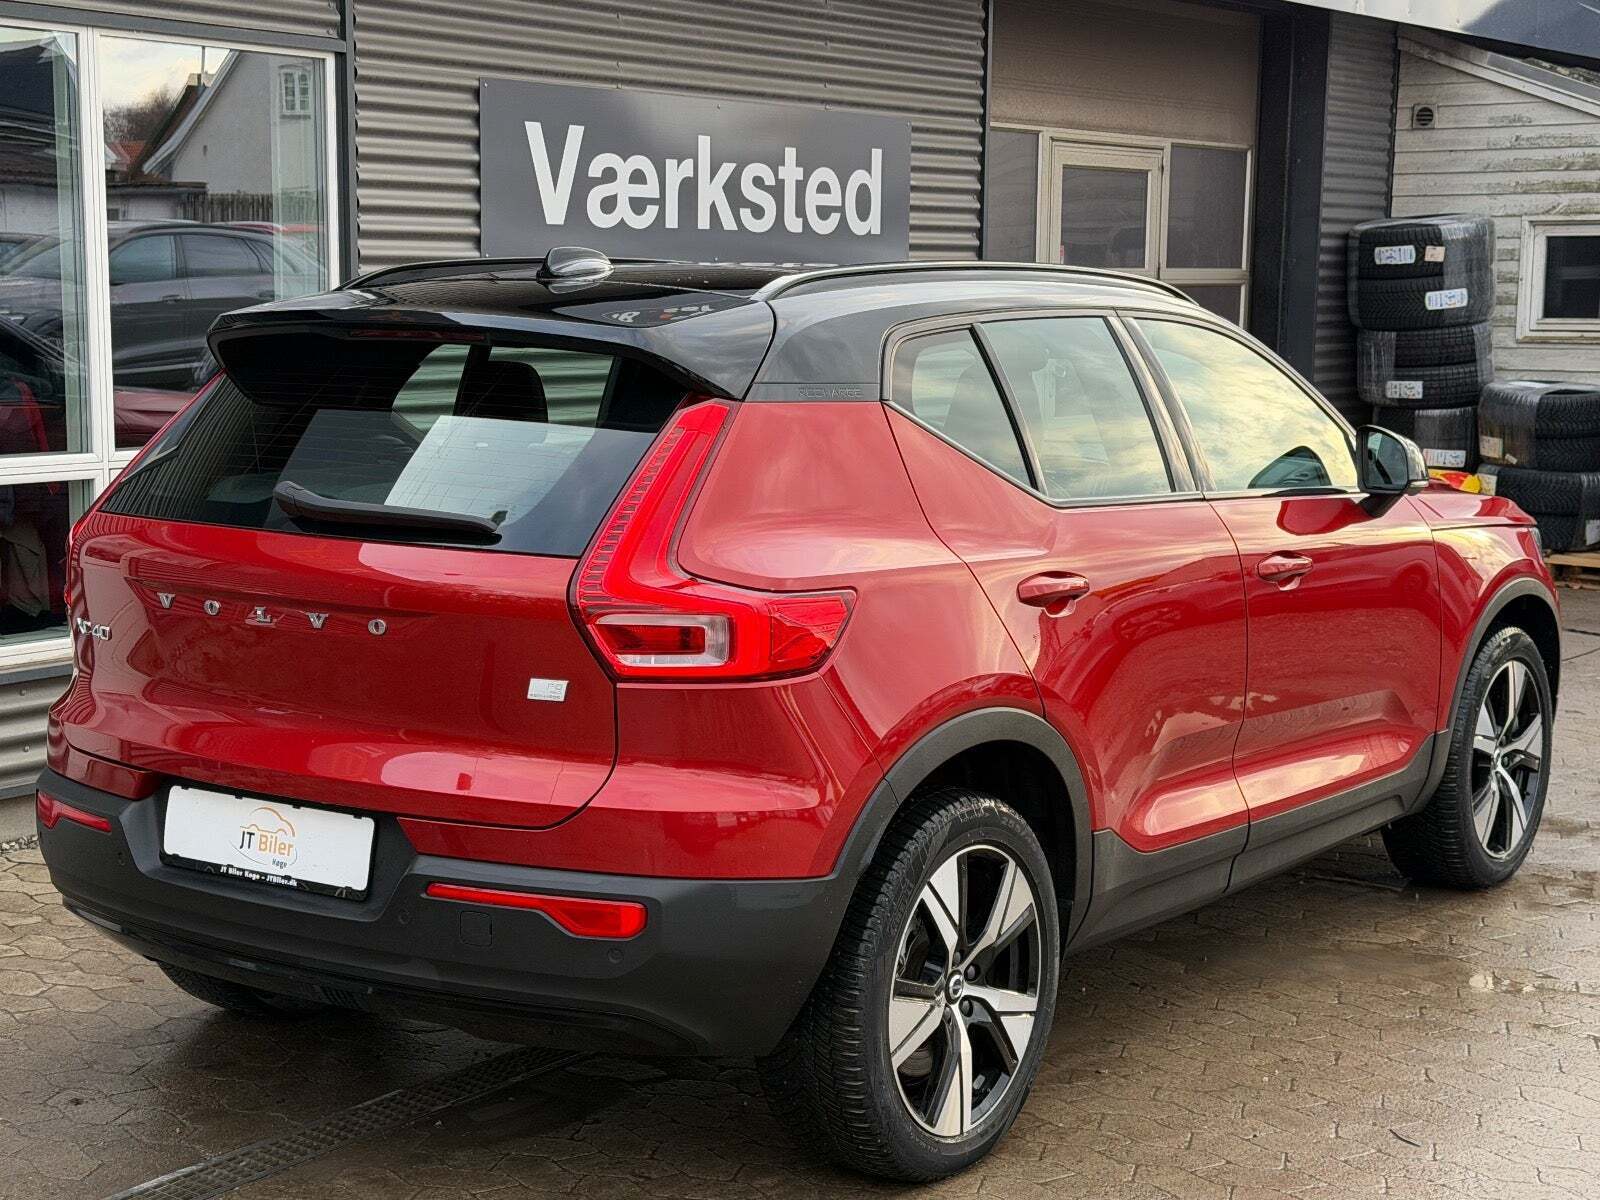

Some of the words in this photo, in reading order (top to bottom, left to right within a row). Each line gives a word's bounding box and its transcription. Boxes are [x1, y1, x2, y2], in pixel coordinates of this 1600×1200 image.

[524, 120, 883, 236] Værksted
[156, 592, 389, 637] VOLVO
[239, 830, 255, 849] JT
[259, 834, 294, 856] Biler
[228, 867, 243, 876] Biler
